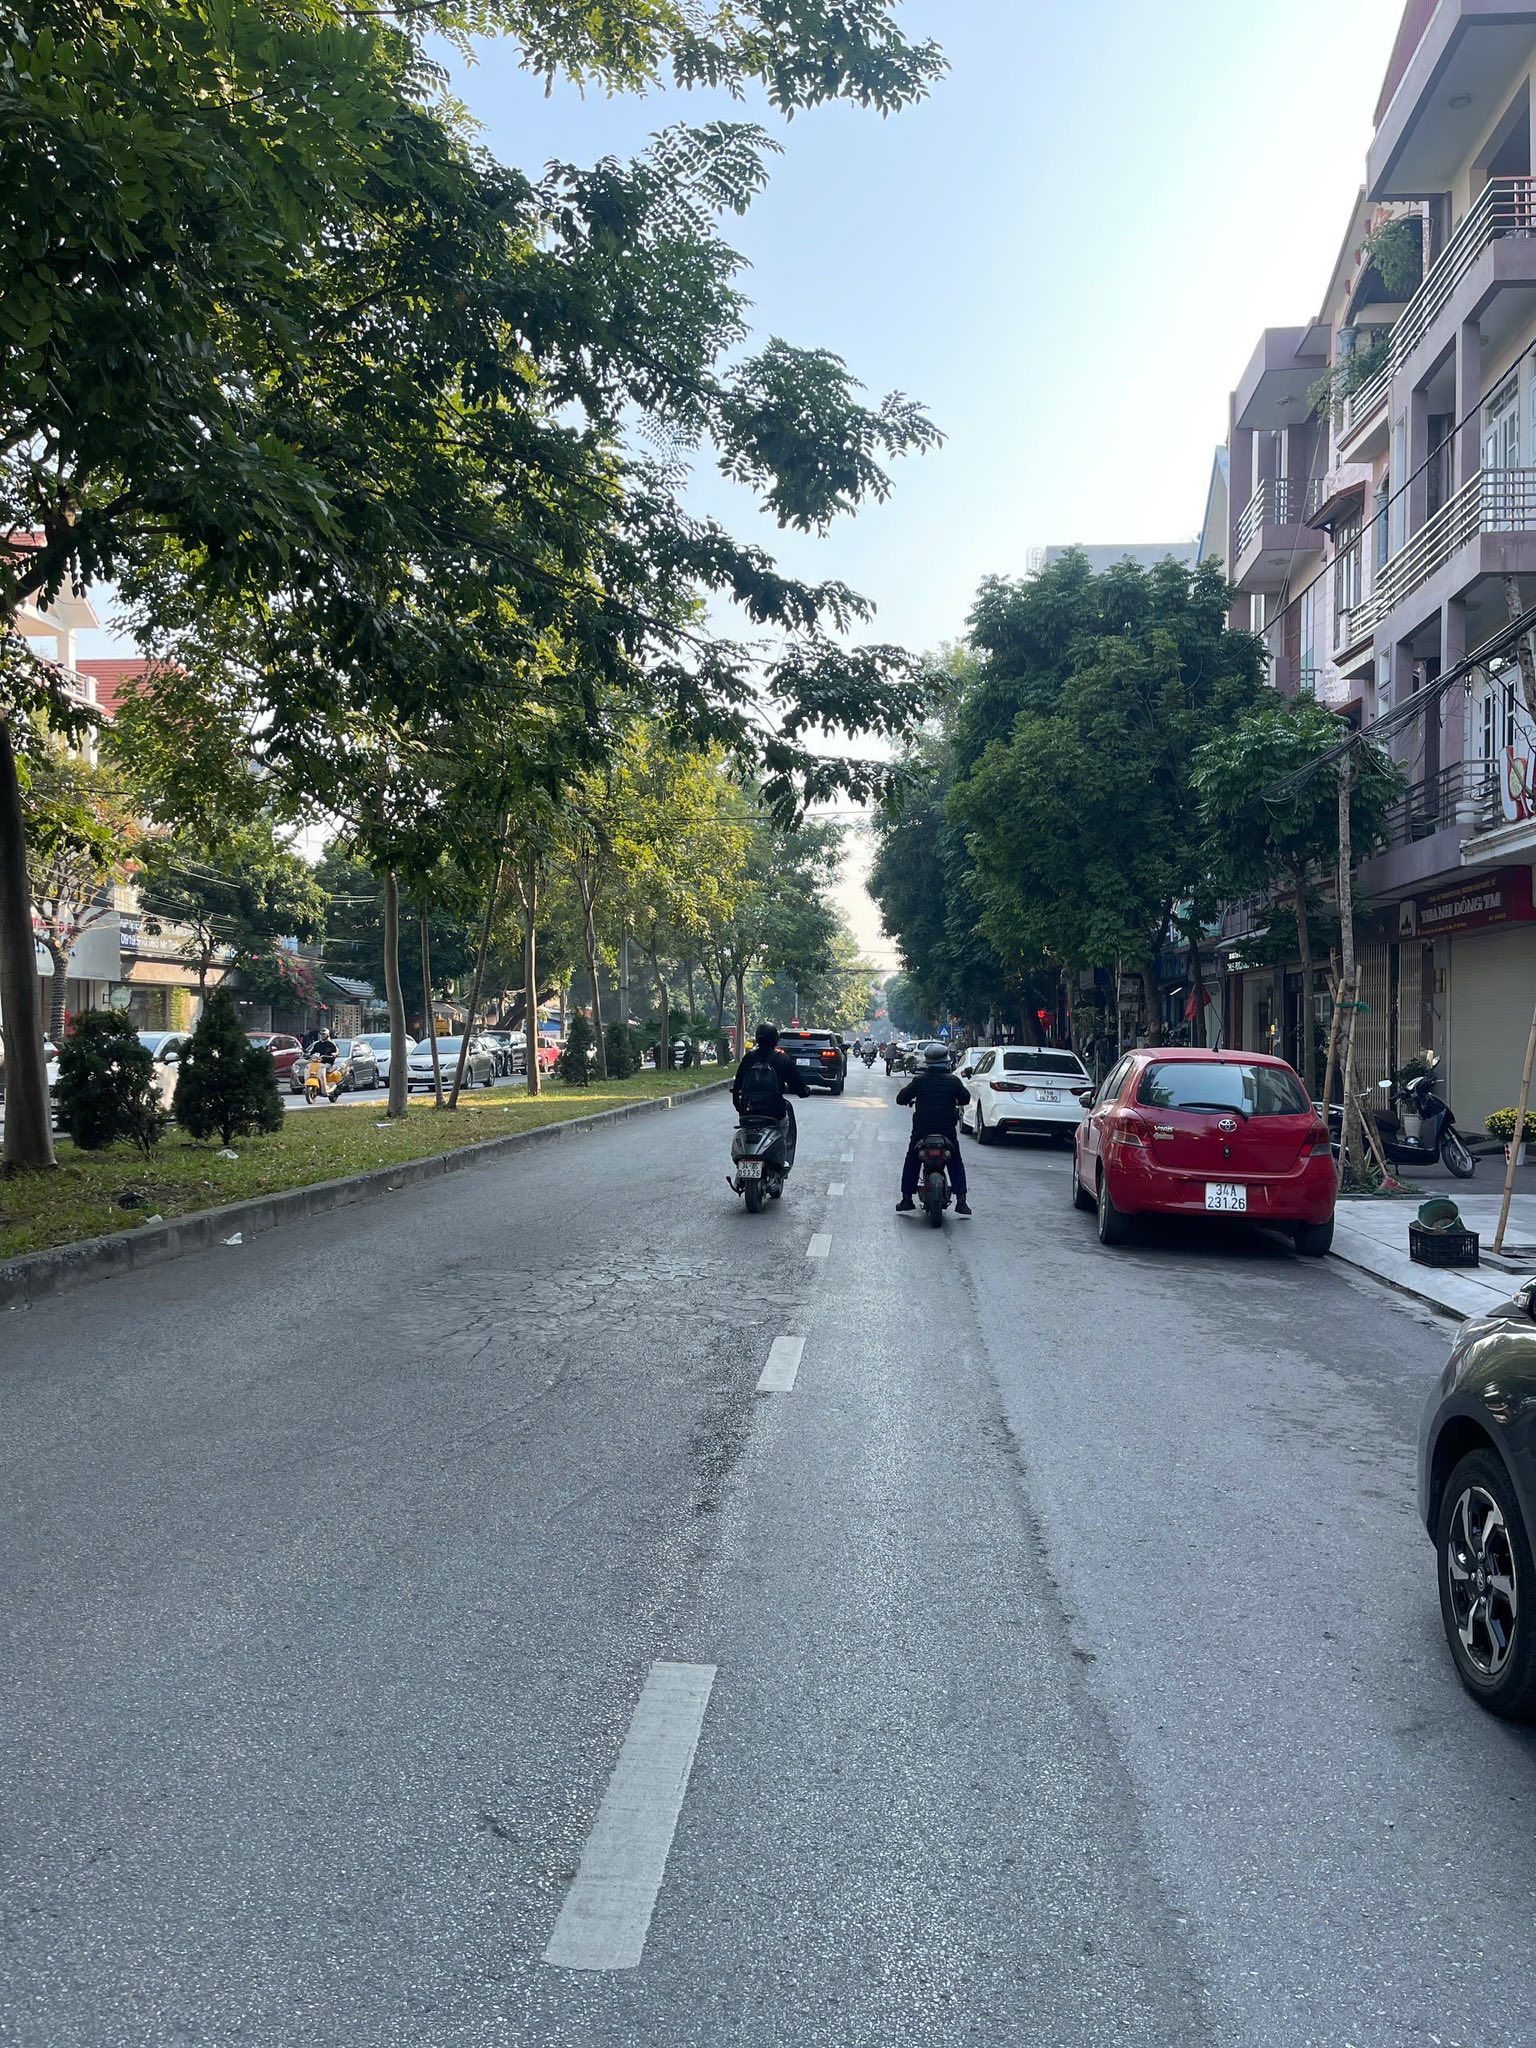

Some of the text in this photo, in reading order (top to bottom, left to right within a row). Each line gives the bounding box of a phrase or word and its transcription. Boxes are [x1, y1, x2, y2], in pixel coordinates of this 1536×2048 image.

[1420, 903, 1452, 923] THÀNH
[1483, 891, 1502, 910] TM
[1215, 1184, 1237, 1197] 34A
[1207, 1197, 1245, 1210] 231.26
